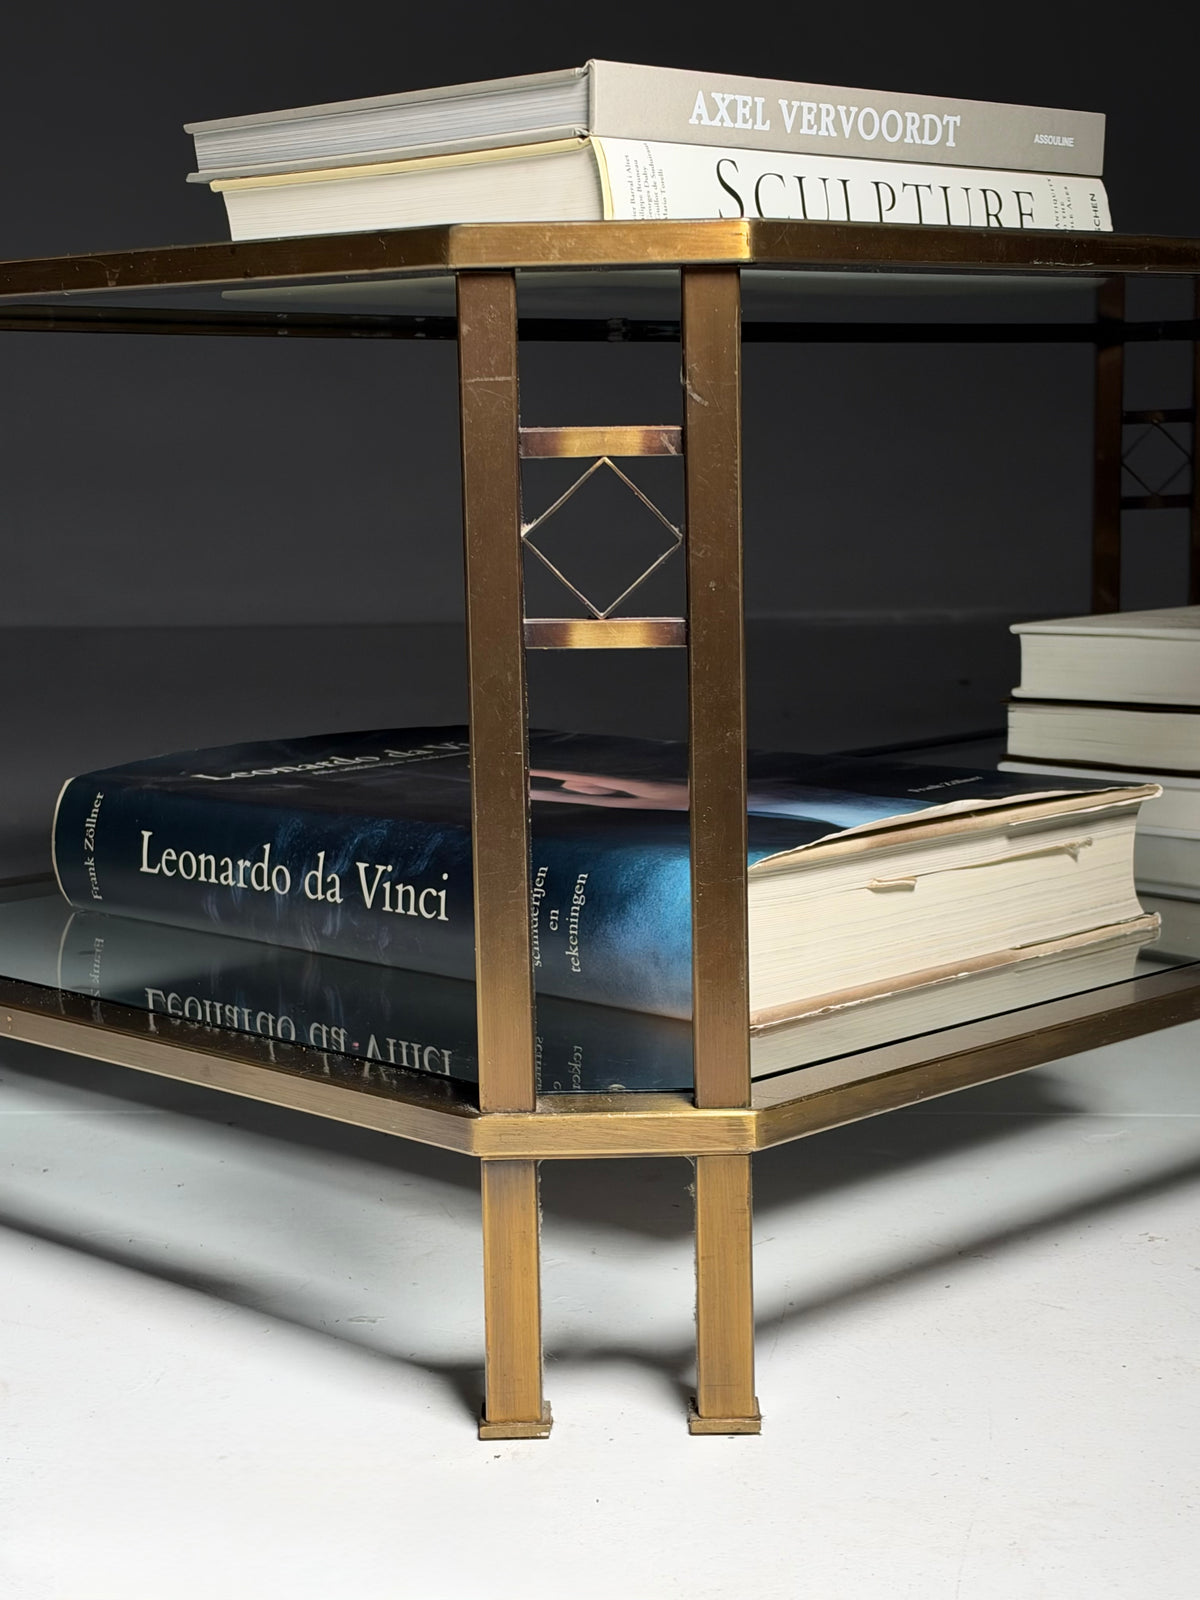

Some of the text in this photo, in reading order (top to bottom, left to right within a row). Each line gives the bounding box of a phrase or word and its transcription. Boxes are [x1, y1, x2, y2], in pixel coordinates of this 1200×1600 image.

[688, 90, 961, 147] AXEL VERVOORDT
[1033, 132, 1075, 148] ASSOULINE
[83, 791, 105, 900] Frank Zöllner
[139, 829, 450, 921] Leonardo da Vinci
[549, 908, 560, 931] en
[565, 872, 589, 973] tekeningen
